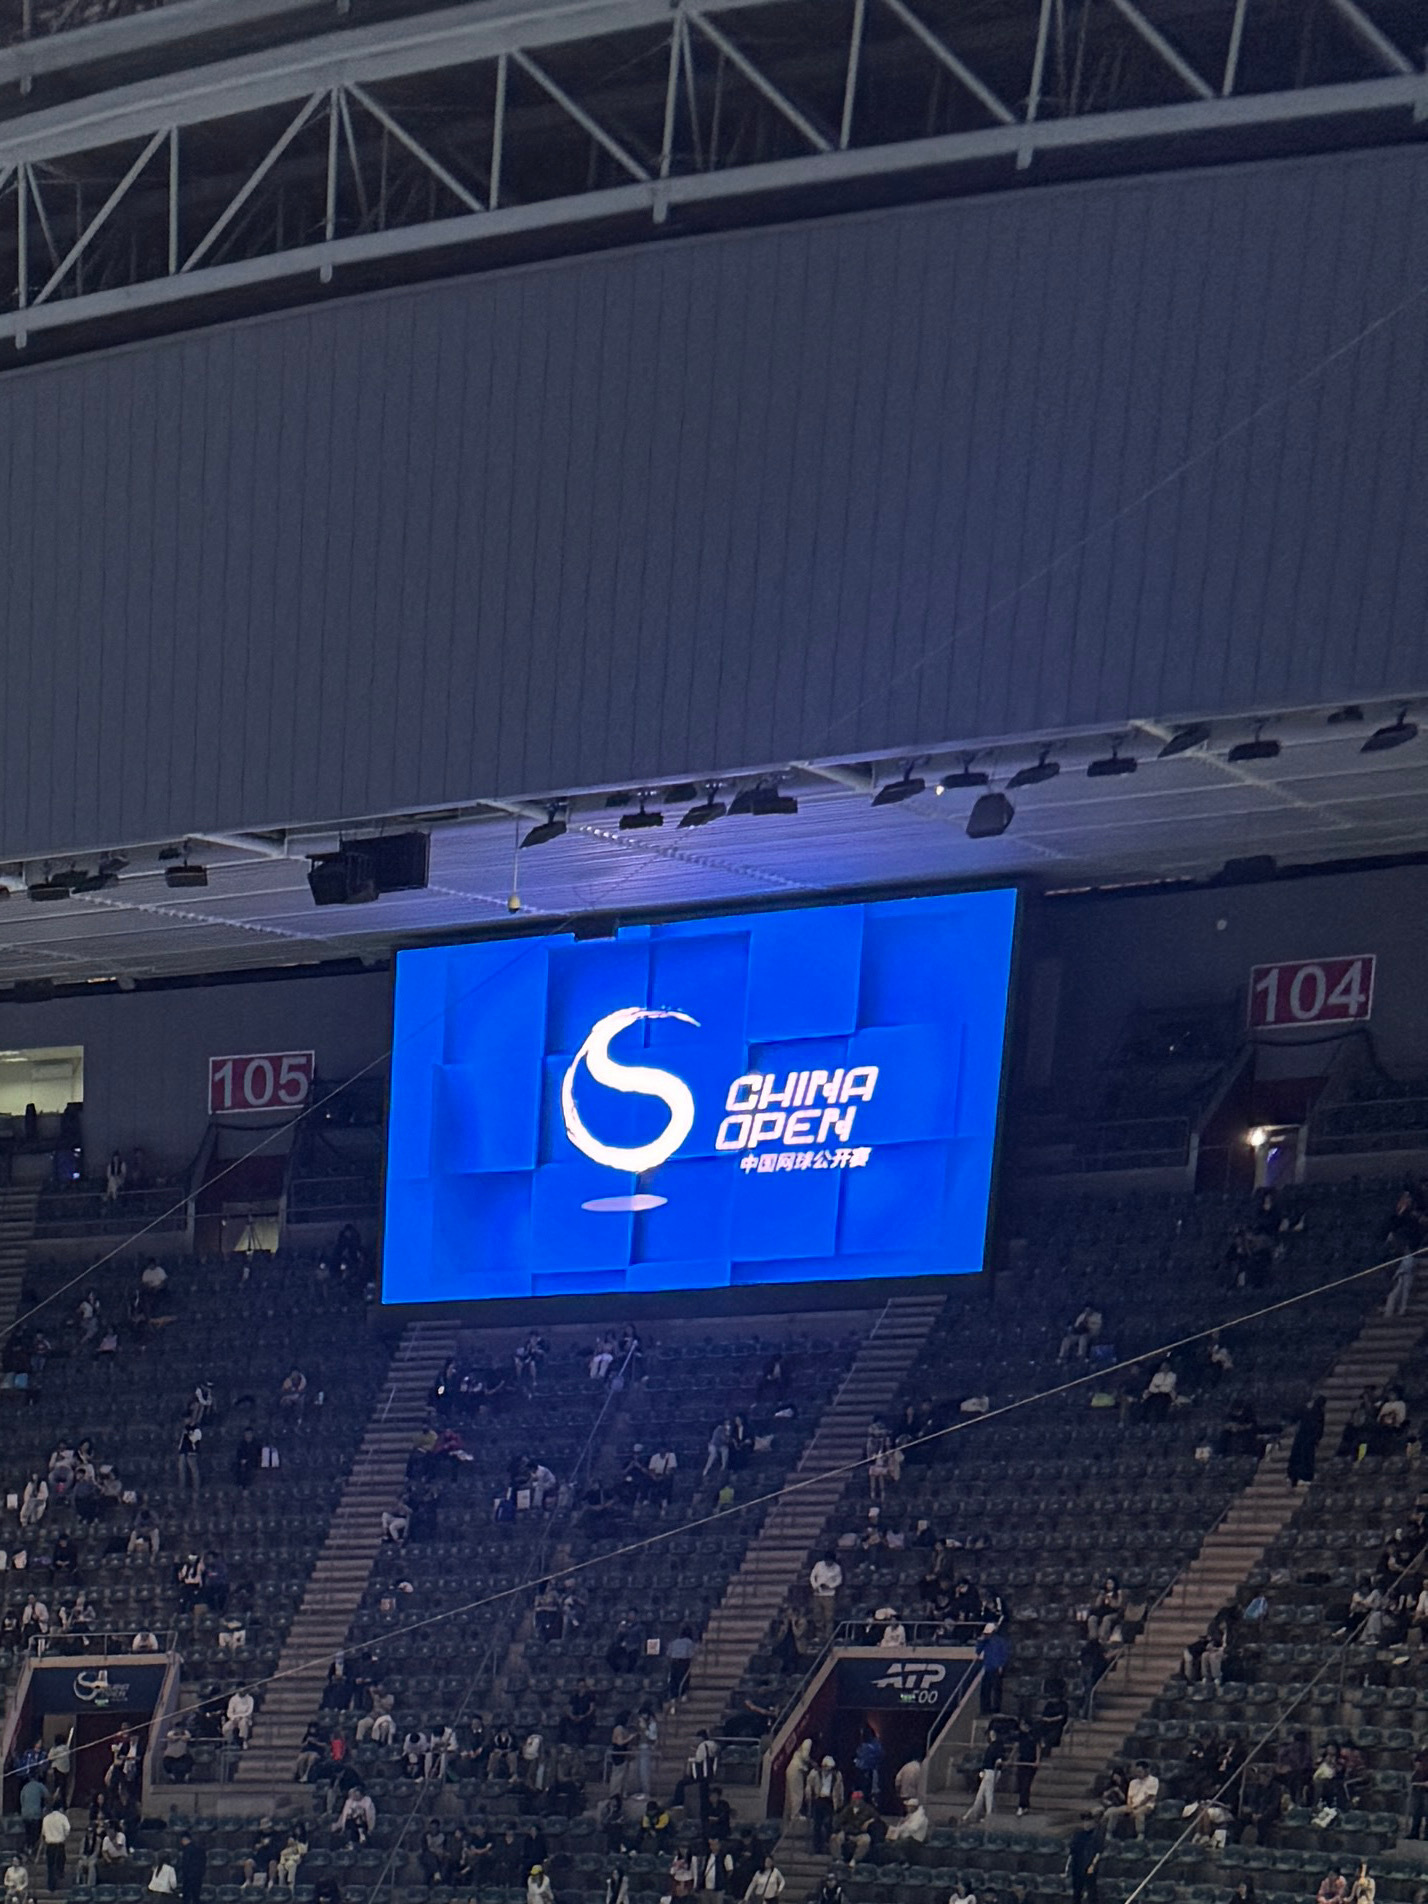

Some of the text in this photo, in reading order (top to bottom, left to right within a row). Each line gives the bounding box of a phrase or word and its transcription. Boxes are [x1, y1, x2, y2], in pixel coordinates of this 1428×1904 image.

[1254, 960, 1366, 1022] 104
[212, 1057, 307, 1106] 105
[725, 1066, 879, 1111] CHINA
[715, 1105, 857, 1150] OPEN
[740, 1147, 872, 1174] 中国网球公开赛
[872, 1663, 945, 1689] ATP
